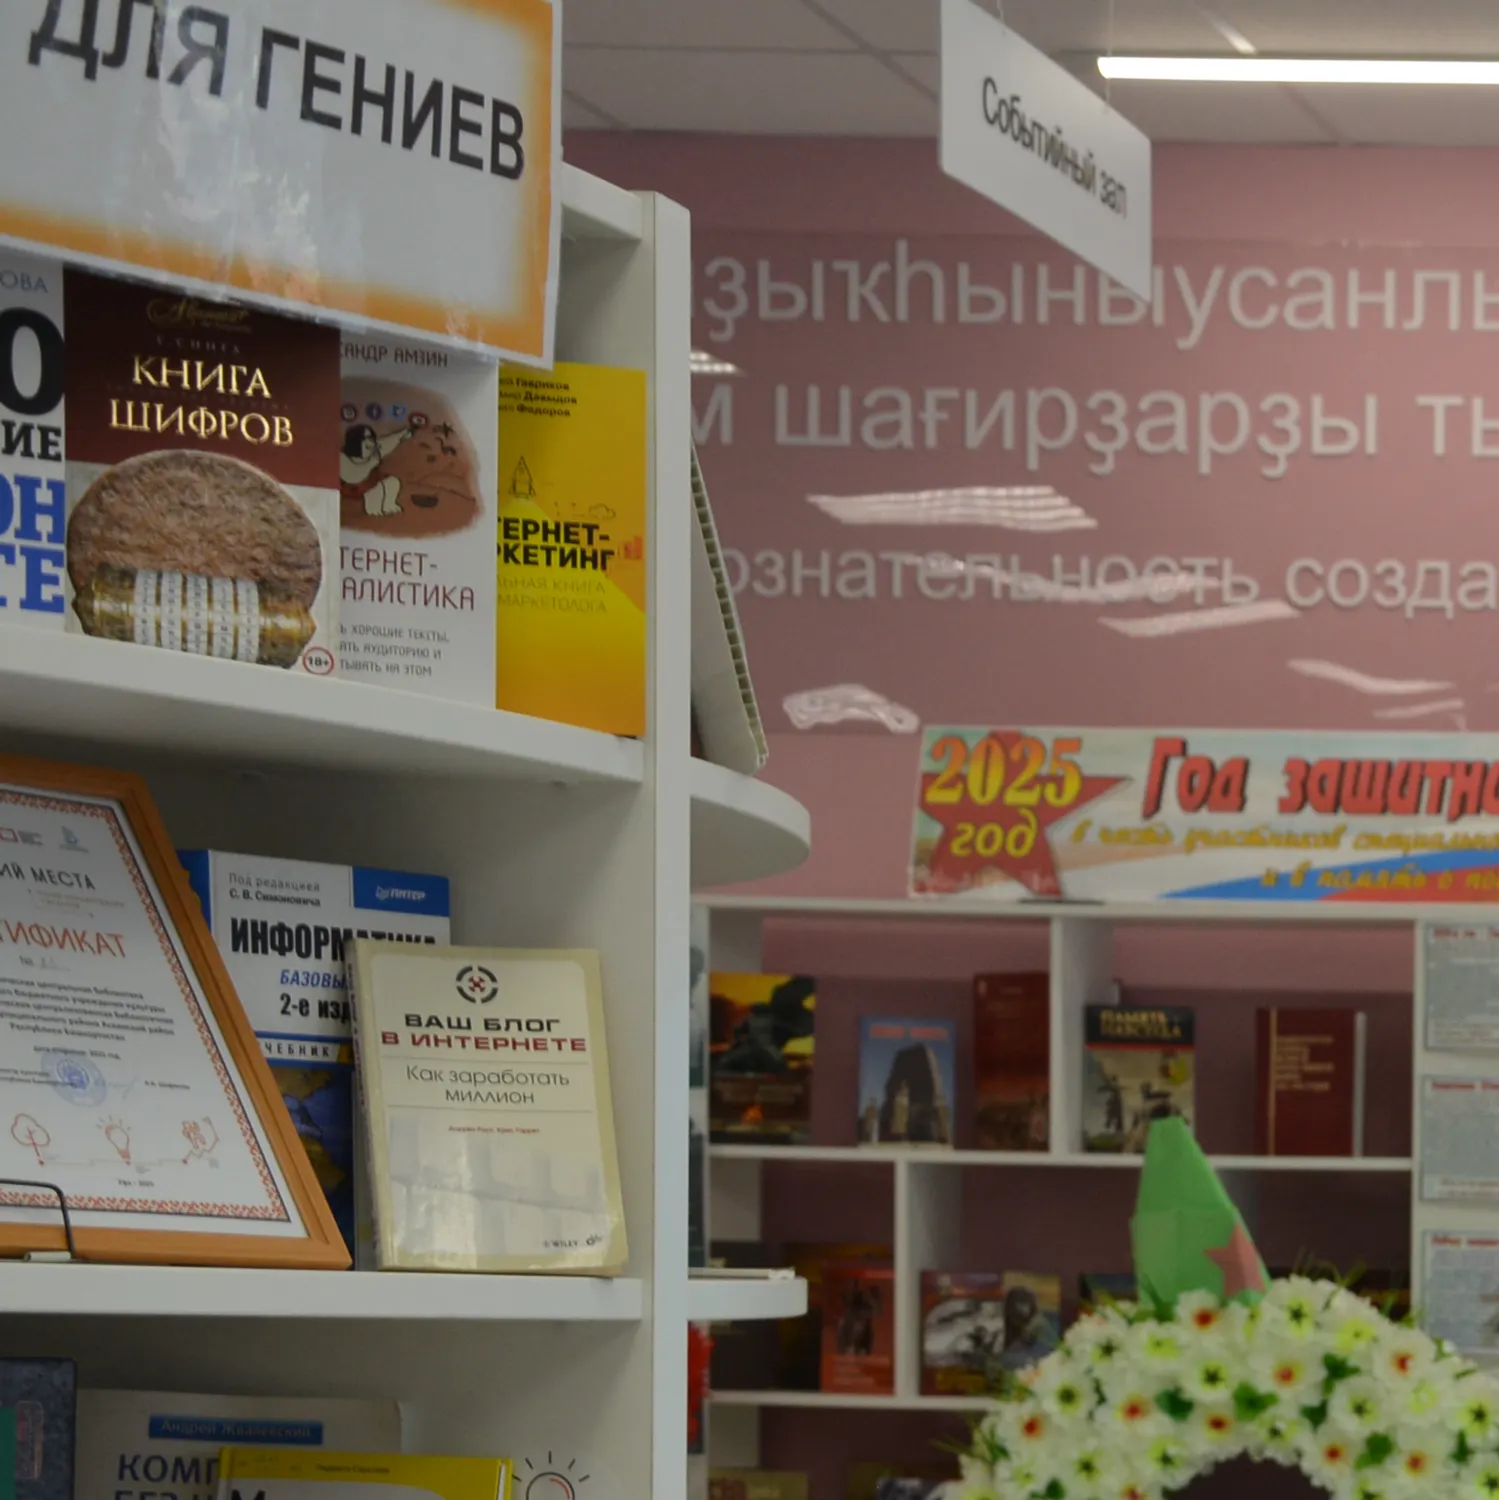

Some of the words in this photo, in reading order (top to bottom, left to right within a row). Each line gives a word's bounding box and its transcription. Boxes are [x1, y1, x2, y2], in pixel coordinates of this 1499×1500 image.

[29, 0, 230, 98] ДЛЯ
[255, 26, 525, 181] ГЕНИЕВ
[983, 76, 1096, 197] Событийный
[1100, 170, 1127, 220] зал
[394, 344, 449, 369] АМЗИН
[132, 354, 272, 399] КНИГА
[109, 399, 294, 447] ШИФРОВ
[342, 576, 476, 613] АЛИСТИКА
[351, 624, 404, 640] ХОРОШИЕ
[305, 653, 331, 669] 18+
[363, 643, 430, 659] АУДИТОРИЮ
[433, 648, 442, 660] И
[385, 662, 401, 675] НА
[404, 665, 433, 677] ЭТОМ
[926, 735, 1084, 809] 2025
[1142, 736, 1252, 821] Год
[950, 807, 1039, 858] год
[30, 865, 97, 891] МЕСТА
[229, 871, 253, 887] Под
[256, 876, 321, 893] редакцией
[230, 887, 241, 901] С.
[243, 887, 254, 901] В.
[255, 889, 322, 908] Симоновича
[0, 918, 126, 959] ИФИКАТ
[230, 915, 437, 963] ИНФОРМ
[280, 993, 311, 1018] 2-е
[404, 1012, 473, 1032] ВАШ
[484, 1016, 560, 1034] БЛОГ
[260, 1039, 332, 1059] ЧЕБНИК
[381, 1030, 400, 1047] В
[411, 1032, 588, 1053] ИНТЕРНЕТЕ
[406, 1064, 443, 1084] Как
[449, 1067, 571, 1088] заработать
[161, 1419, 217, 1438] Андрей
